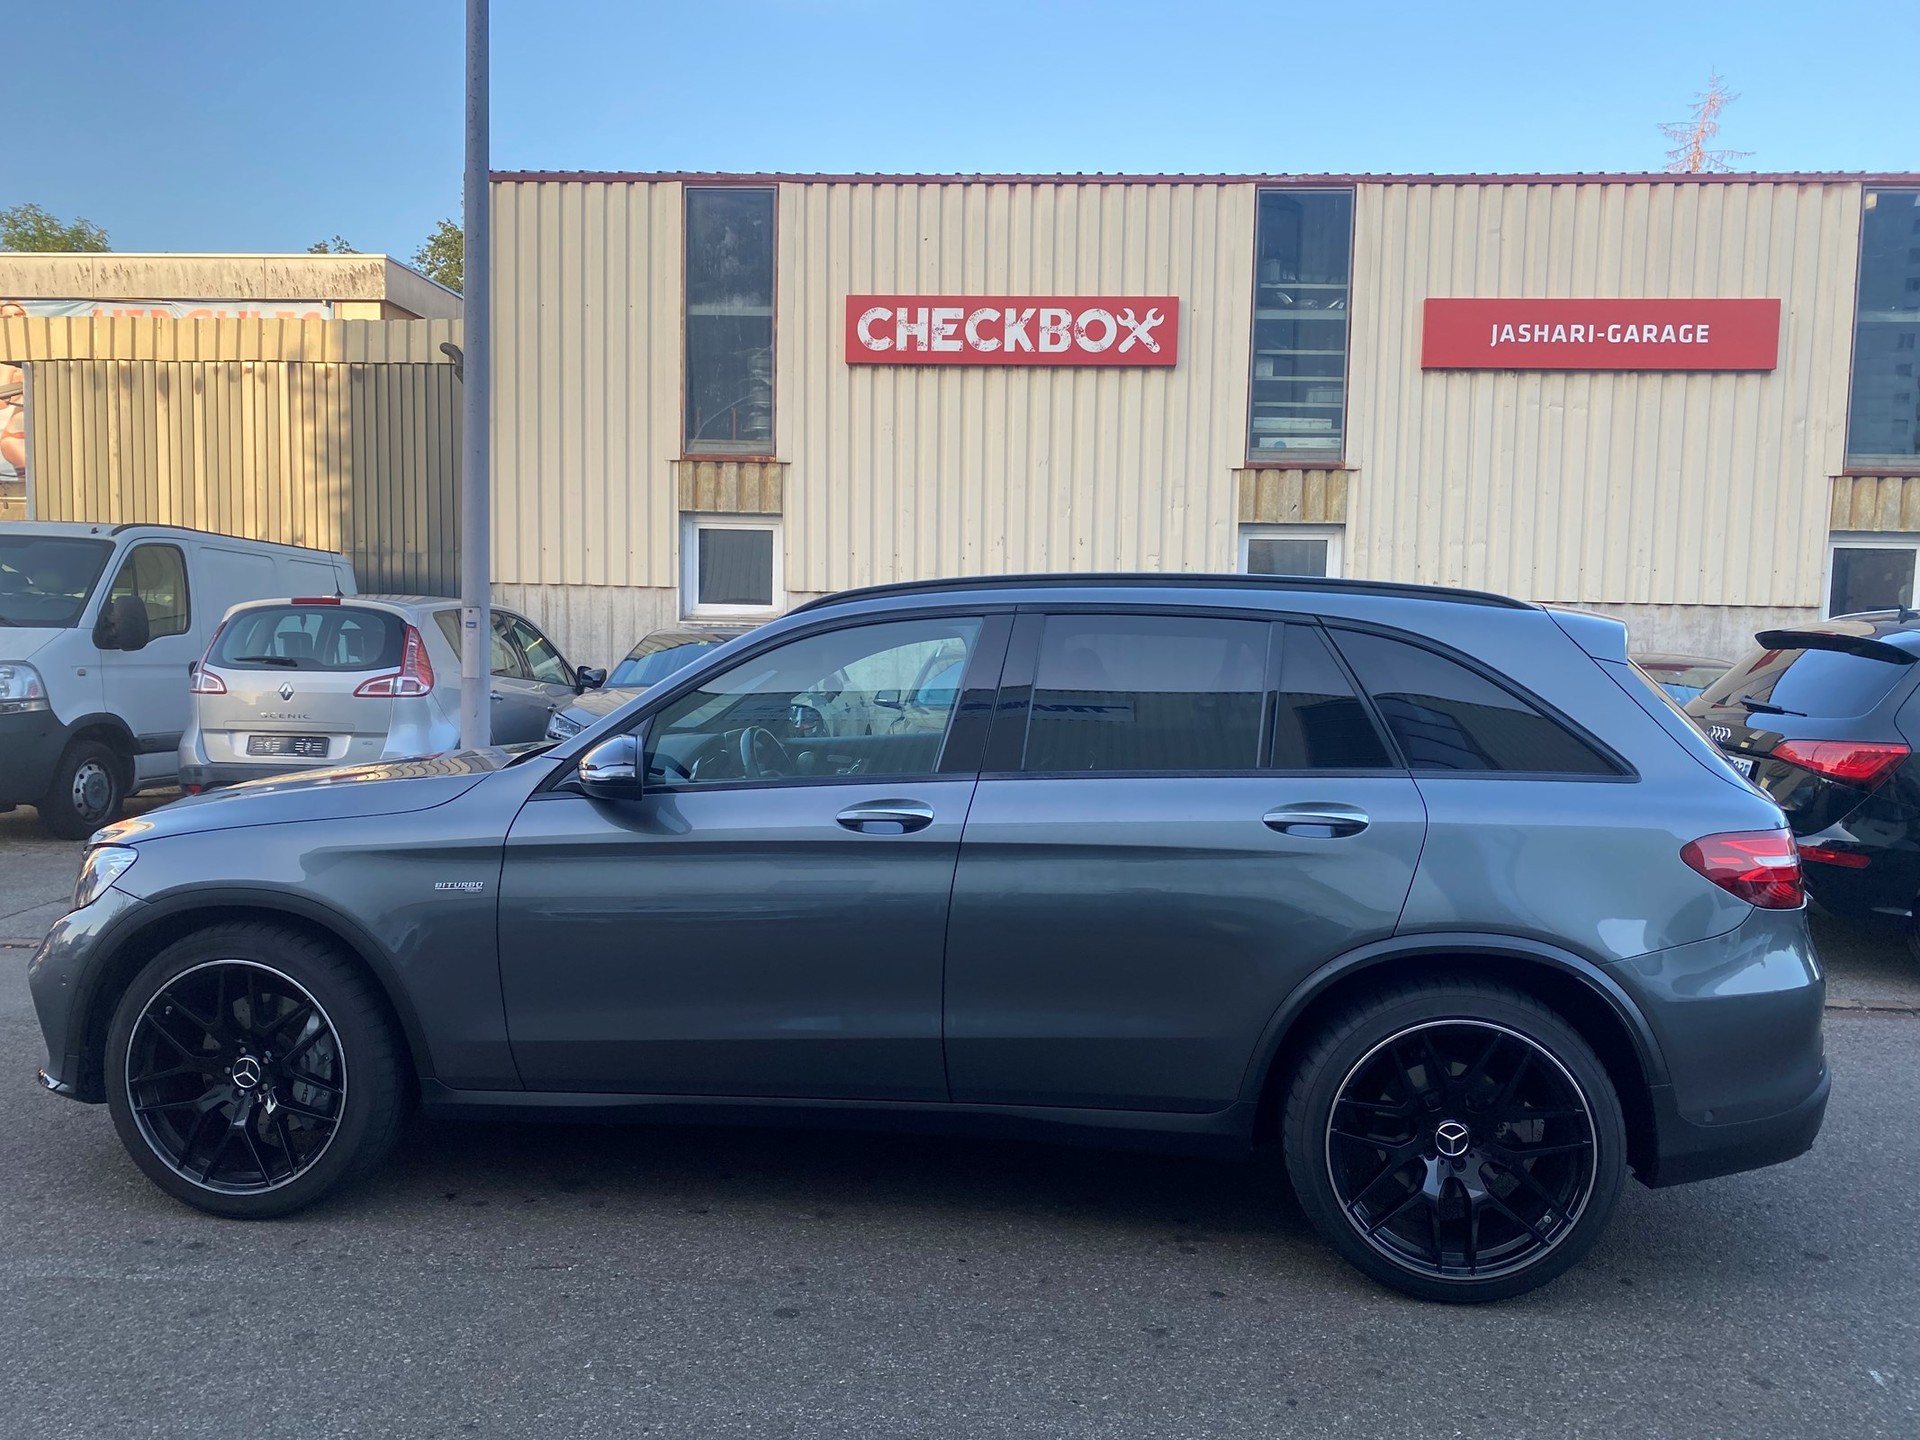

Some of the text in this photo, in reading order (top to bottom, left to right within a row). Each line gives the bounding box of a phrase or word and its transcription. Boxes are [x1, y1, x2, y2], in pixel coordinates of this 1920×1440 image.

[857, 306, 1165, 353] CHECKBOX
[1490, 323, 1710, 347] JASHARI-GARAGE
[260, 712, 312, 720] SCENIC
[434, 881, 484, 890] BITURBO
